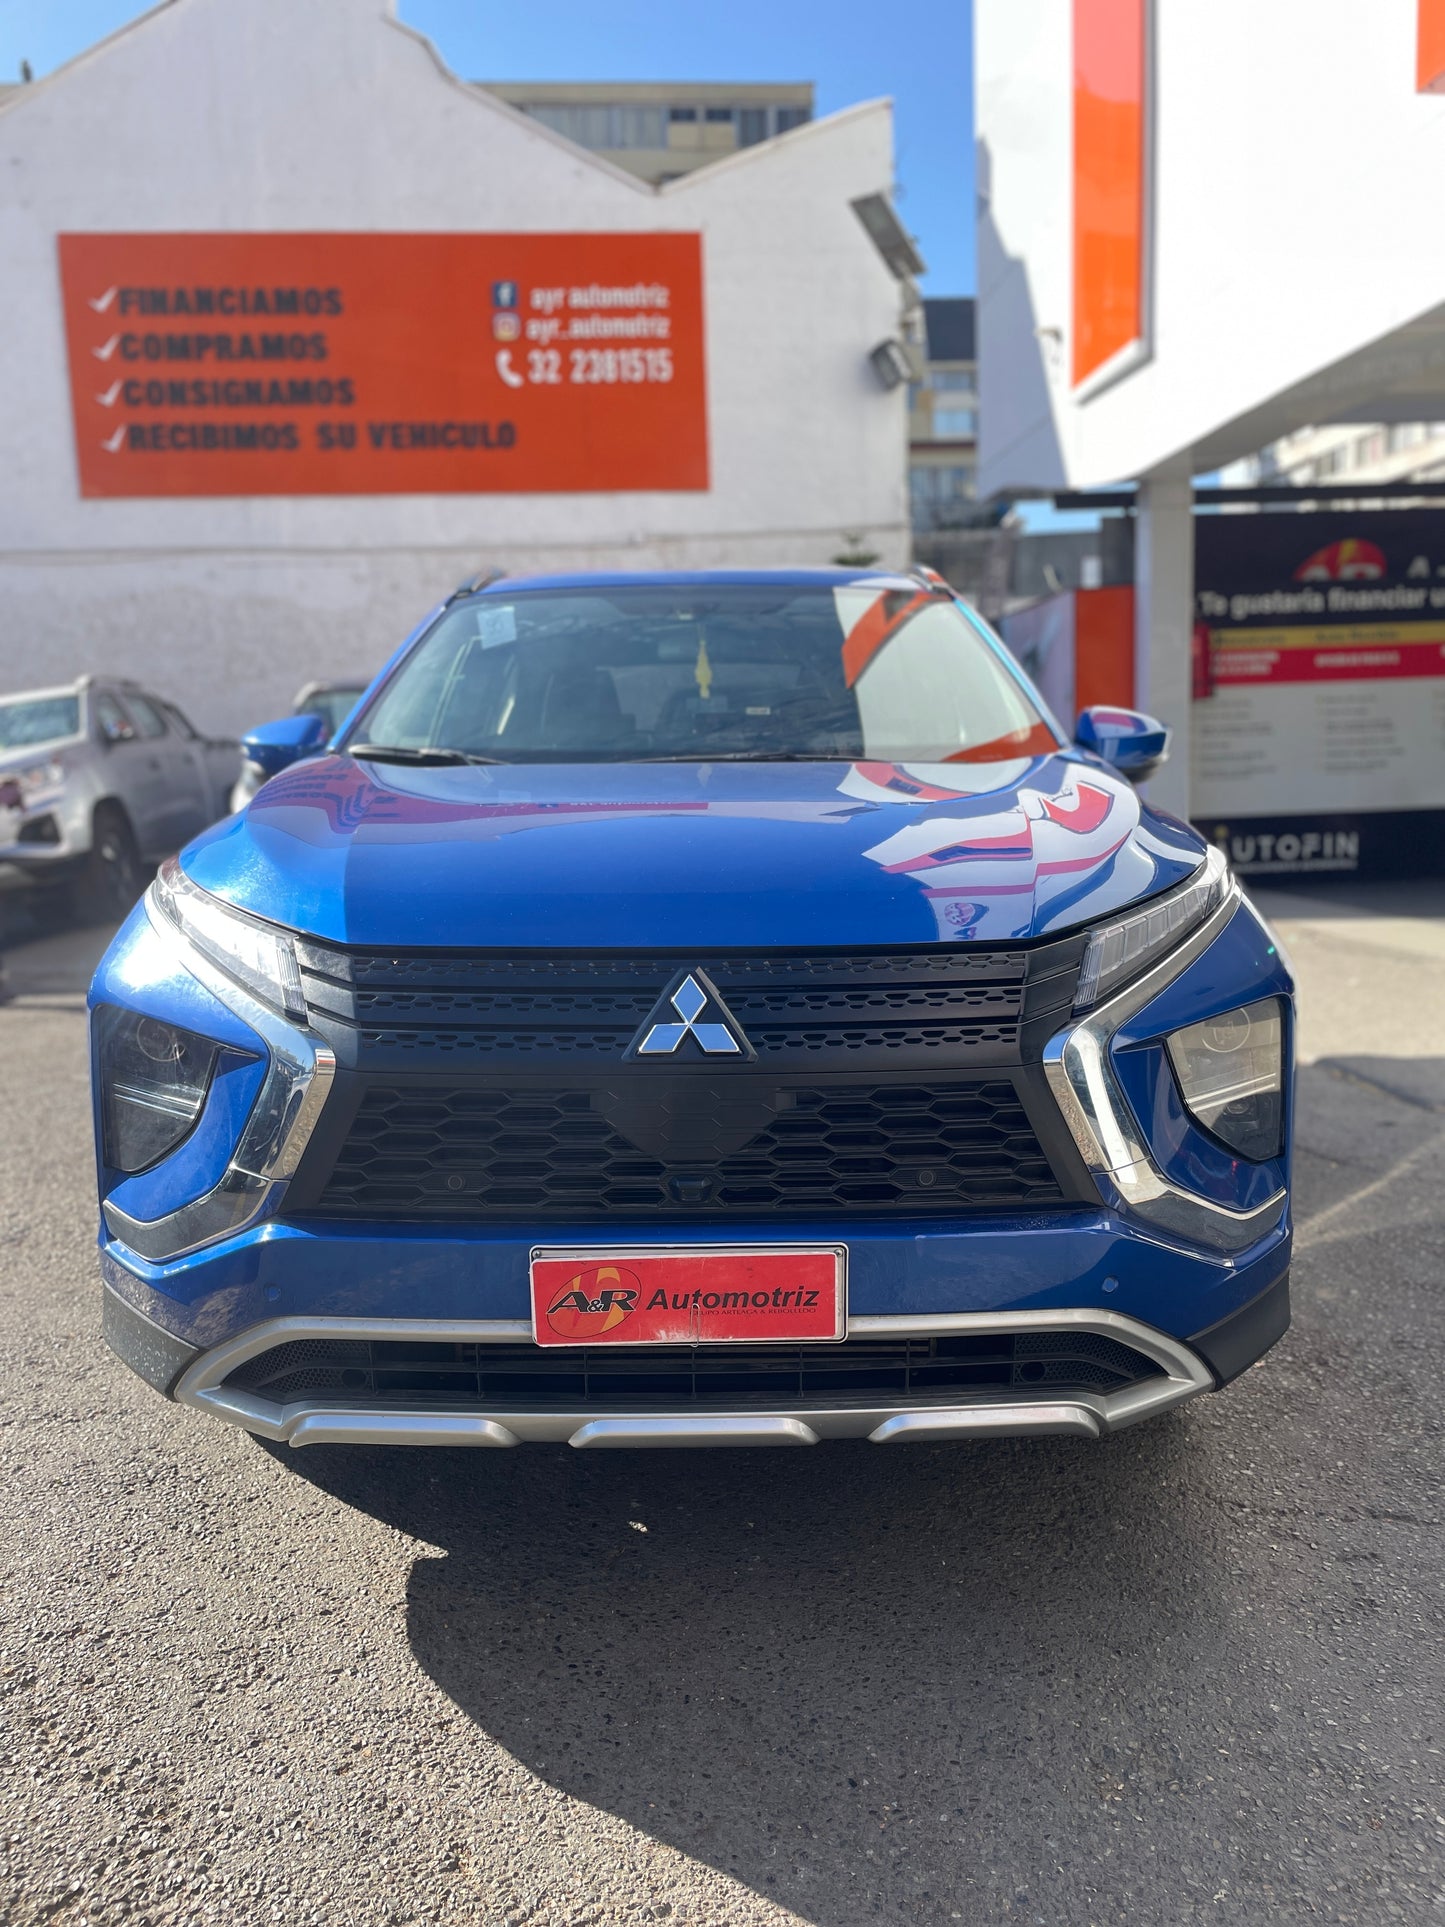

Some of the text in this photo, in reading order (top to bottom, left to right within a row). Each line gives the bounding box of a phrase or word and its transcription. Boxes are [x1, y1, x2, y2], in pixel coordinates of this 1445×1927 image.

[118, 287, 343, 316] FINANCIAMOS
[530, 283, 670, 314] ayr automotriz
[120, 332, 328, 361] COMPRAMOS
[528, 347, 674, 384] 32 2381515
[123, 378, 355, 407] CONSIGNAMOS
[127, 421, 517, 451] RECIBIMOS SU VEHICULO
[1198, 590, 1228, 616] Te
[1327, 584, 1428, 612] financiar
[1218, 832, 1359, 862] UTOFIN
[546, 1285, 819, 1314] A&R Automotriz
